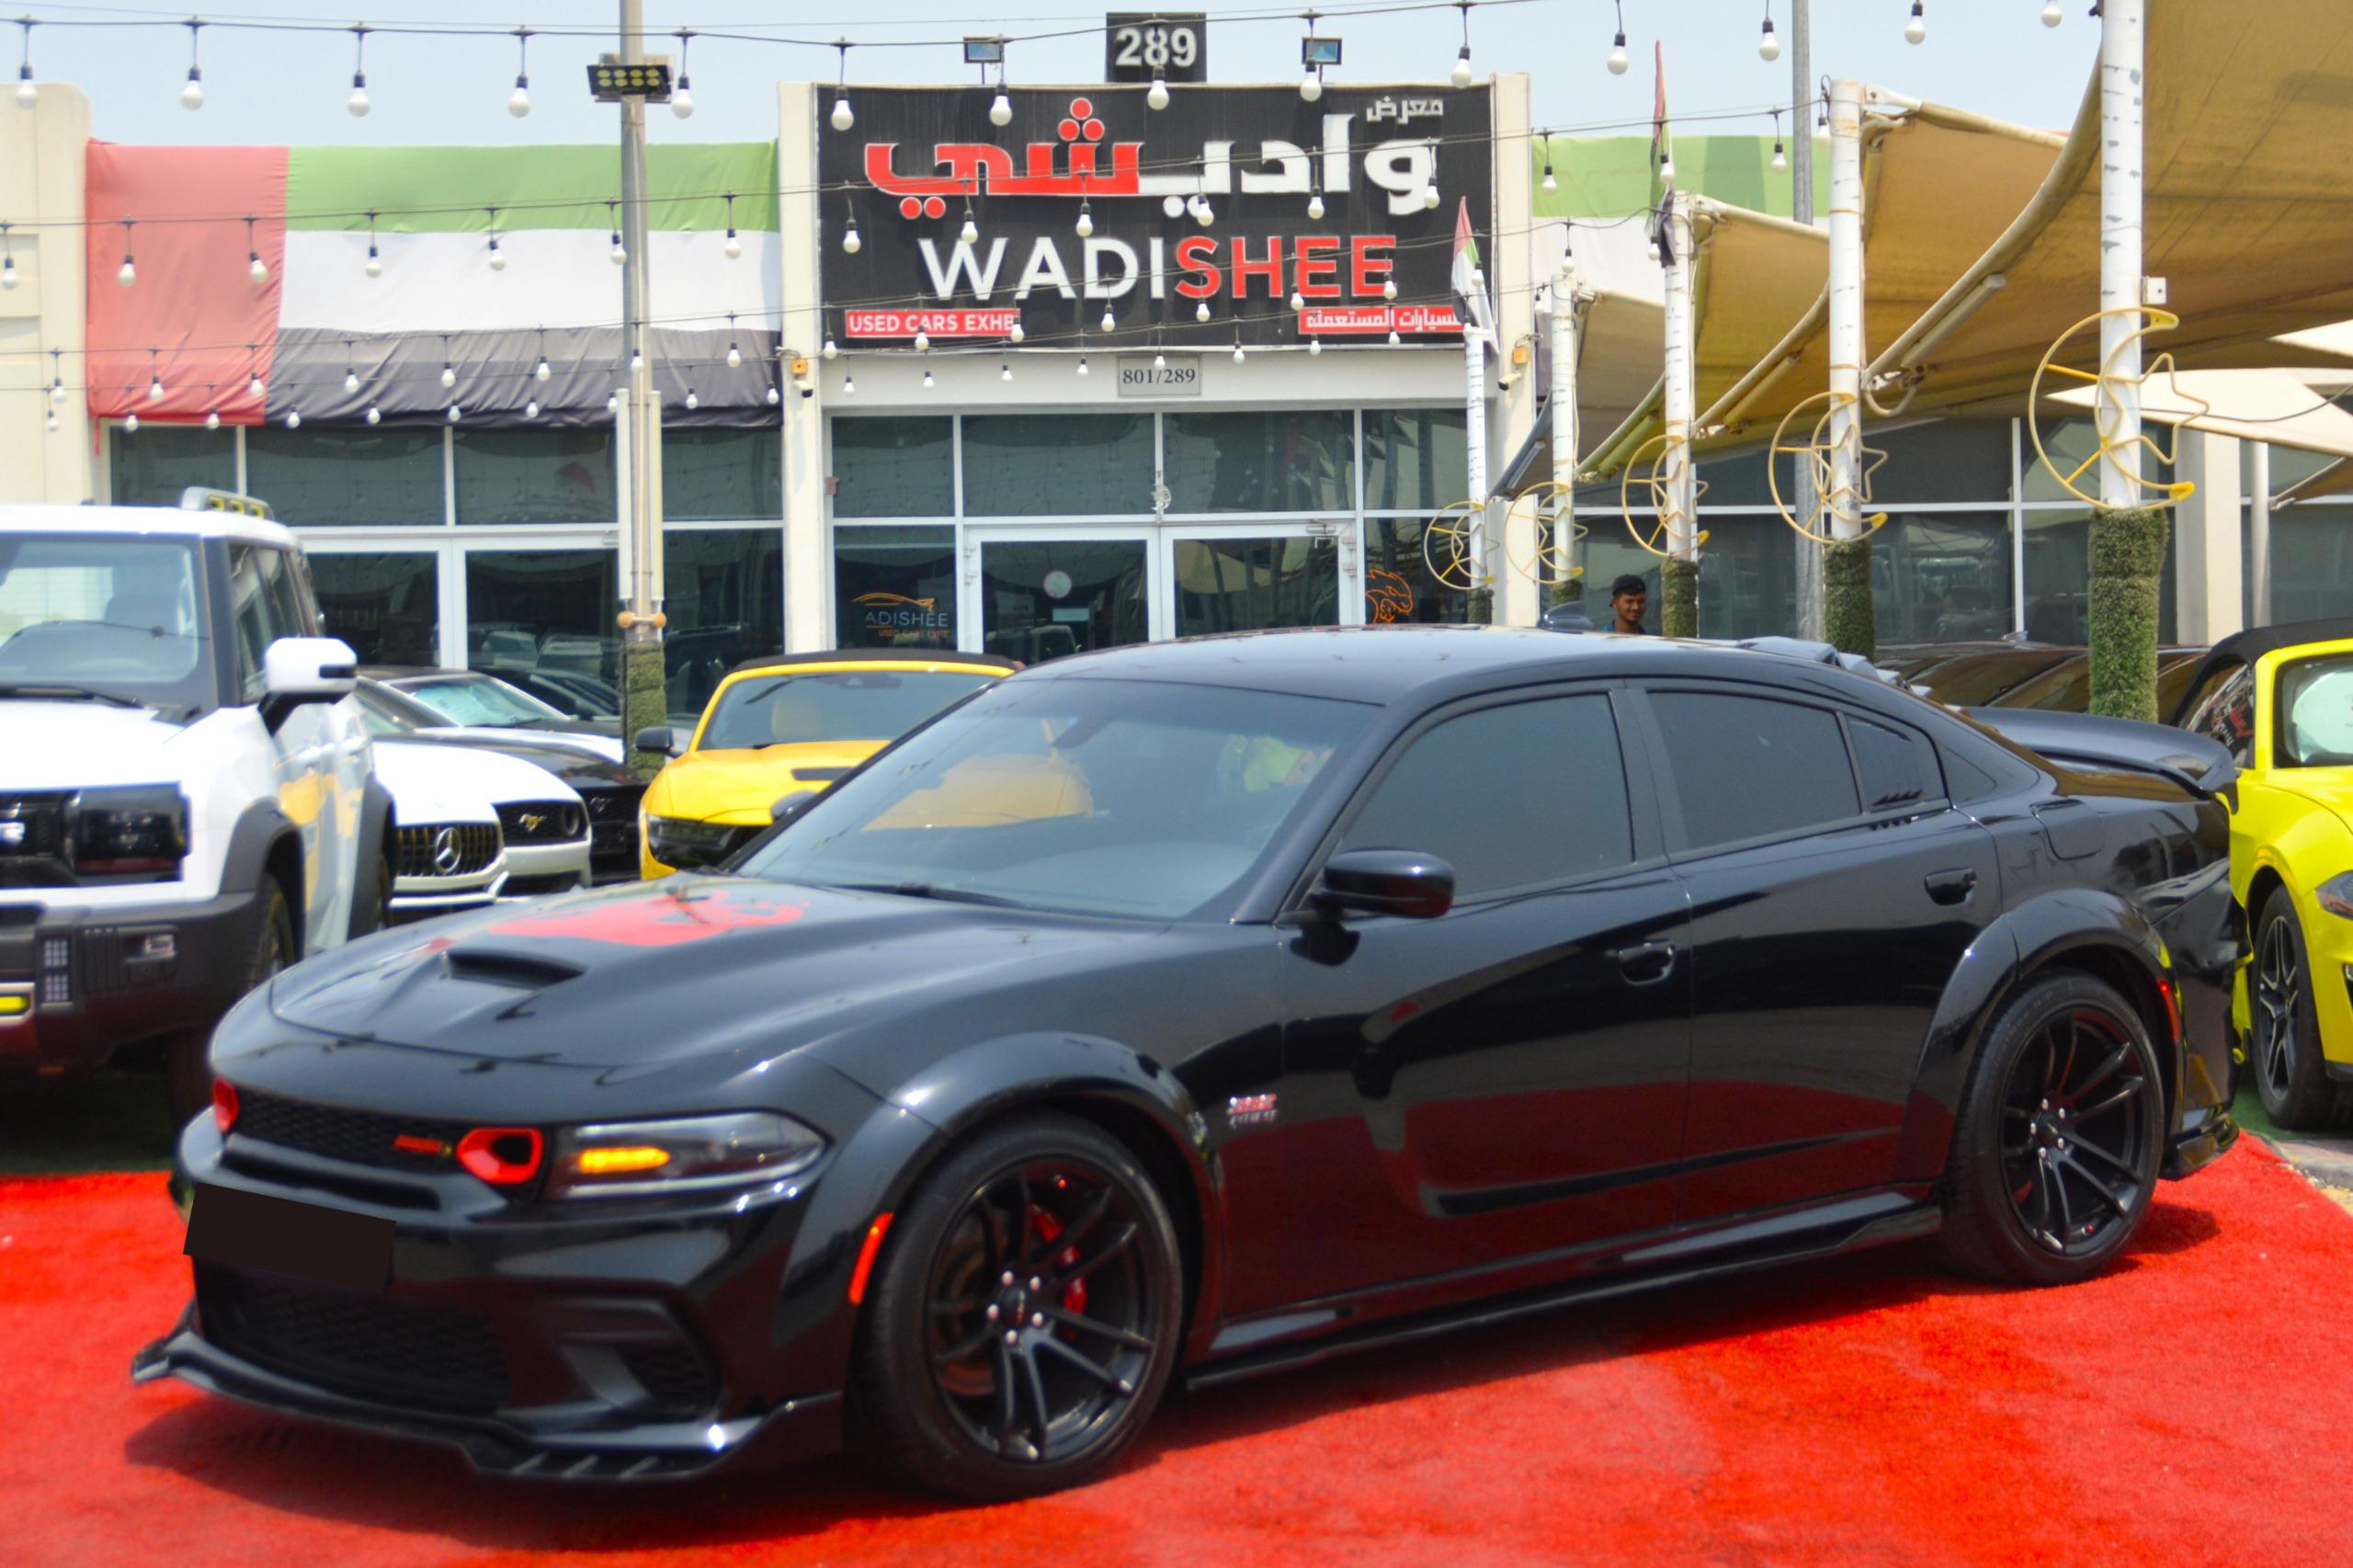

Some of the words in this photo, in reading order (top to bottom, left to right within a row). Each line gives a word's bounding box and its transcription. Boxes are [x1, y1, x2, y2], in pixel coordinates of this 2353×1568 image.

[1115, 27, 1197, 67] 289
[1366, 96, 1444, 125] معرض
[917, 235, 1396, 300] WADISHEE
[848, 314, 900, 332] USED
[905, 314, 958, 332] CARS
[1122, 368, 1196, 384] 801/289
[865, 610, 949, 627] ADISHEE
